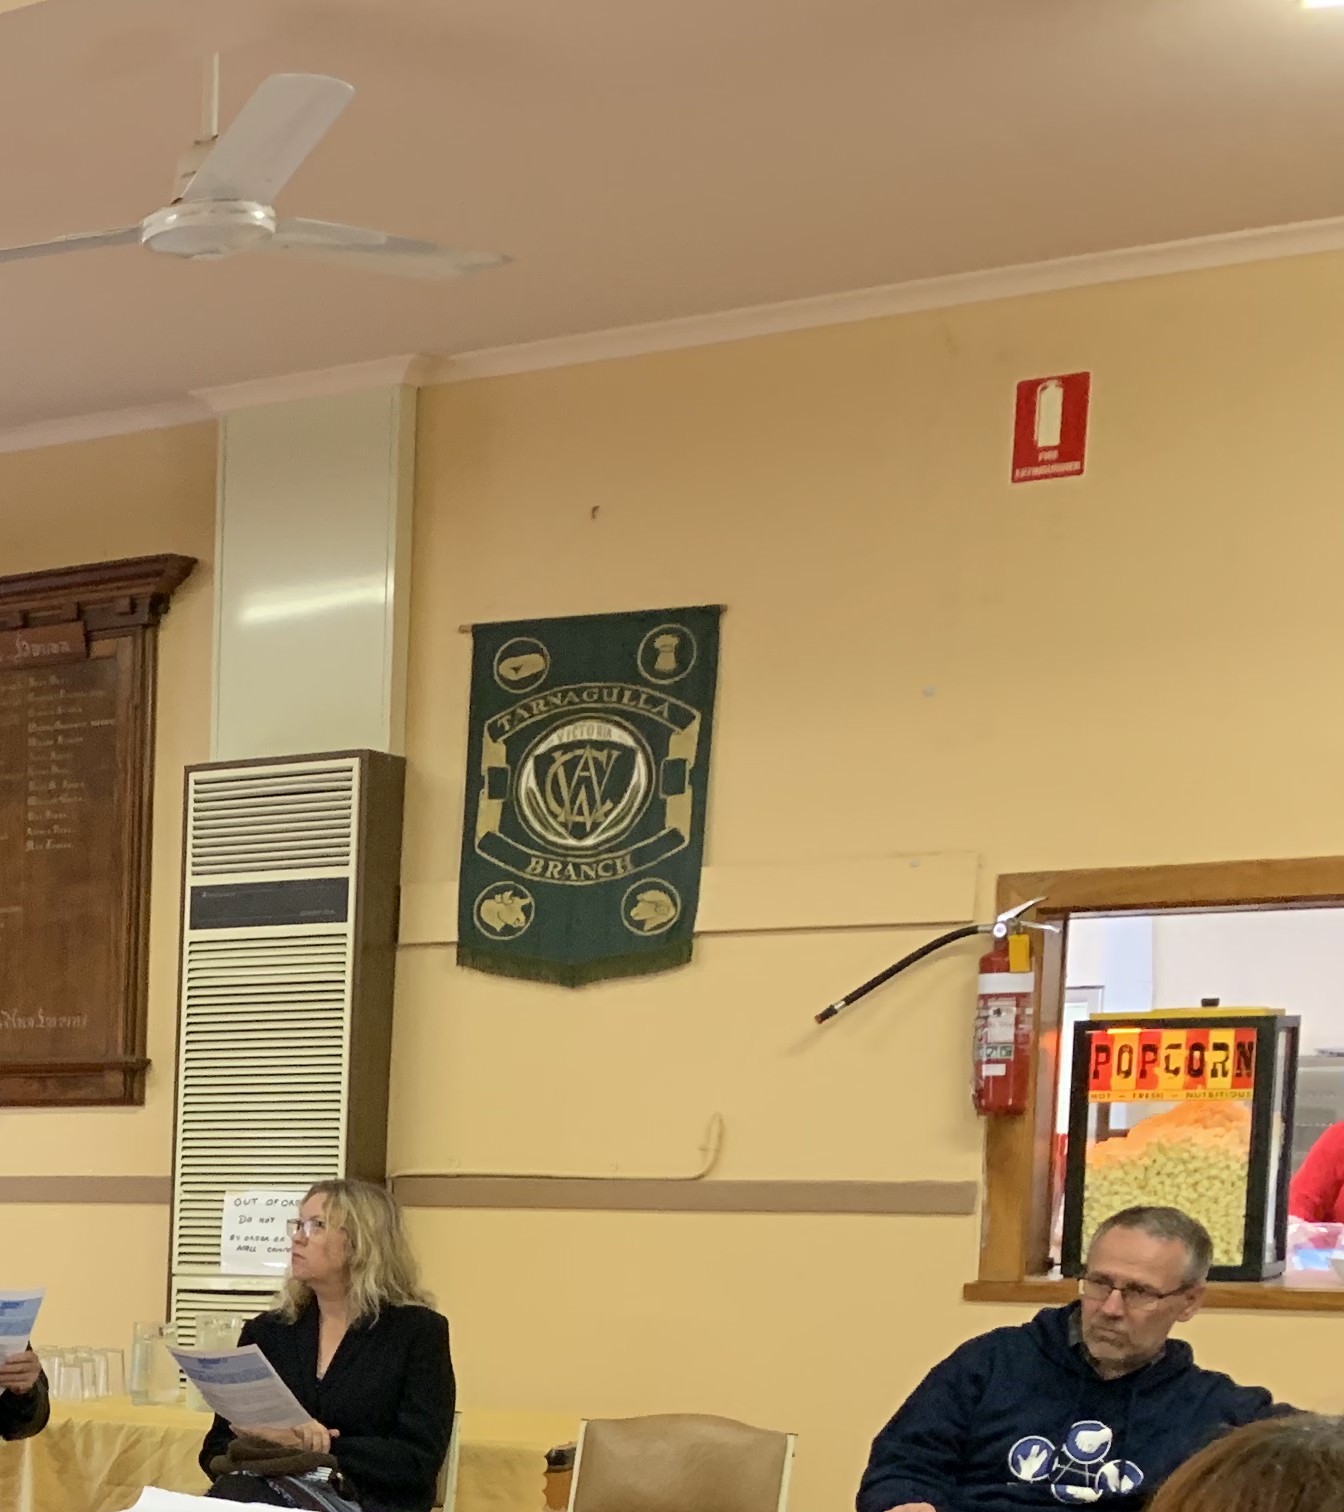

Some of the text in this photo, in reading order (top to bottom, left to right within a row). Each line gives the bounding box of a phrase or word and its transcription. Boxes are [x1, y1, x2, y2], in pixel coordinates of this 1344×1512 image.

[497, 687, 671, 733] TARNAGULLA
[556, 720, 613, 744] VICTORIA
[525, 855, 636, 881] BRANCH
[1092, 1041, 1255, 1080] POPCORN
[233, 1197, 259, 1207] OUT
[265, 1198, 280, 1207] OF
